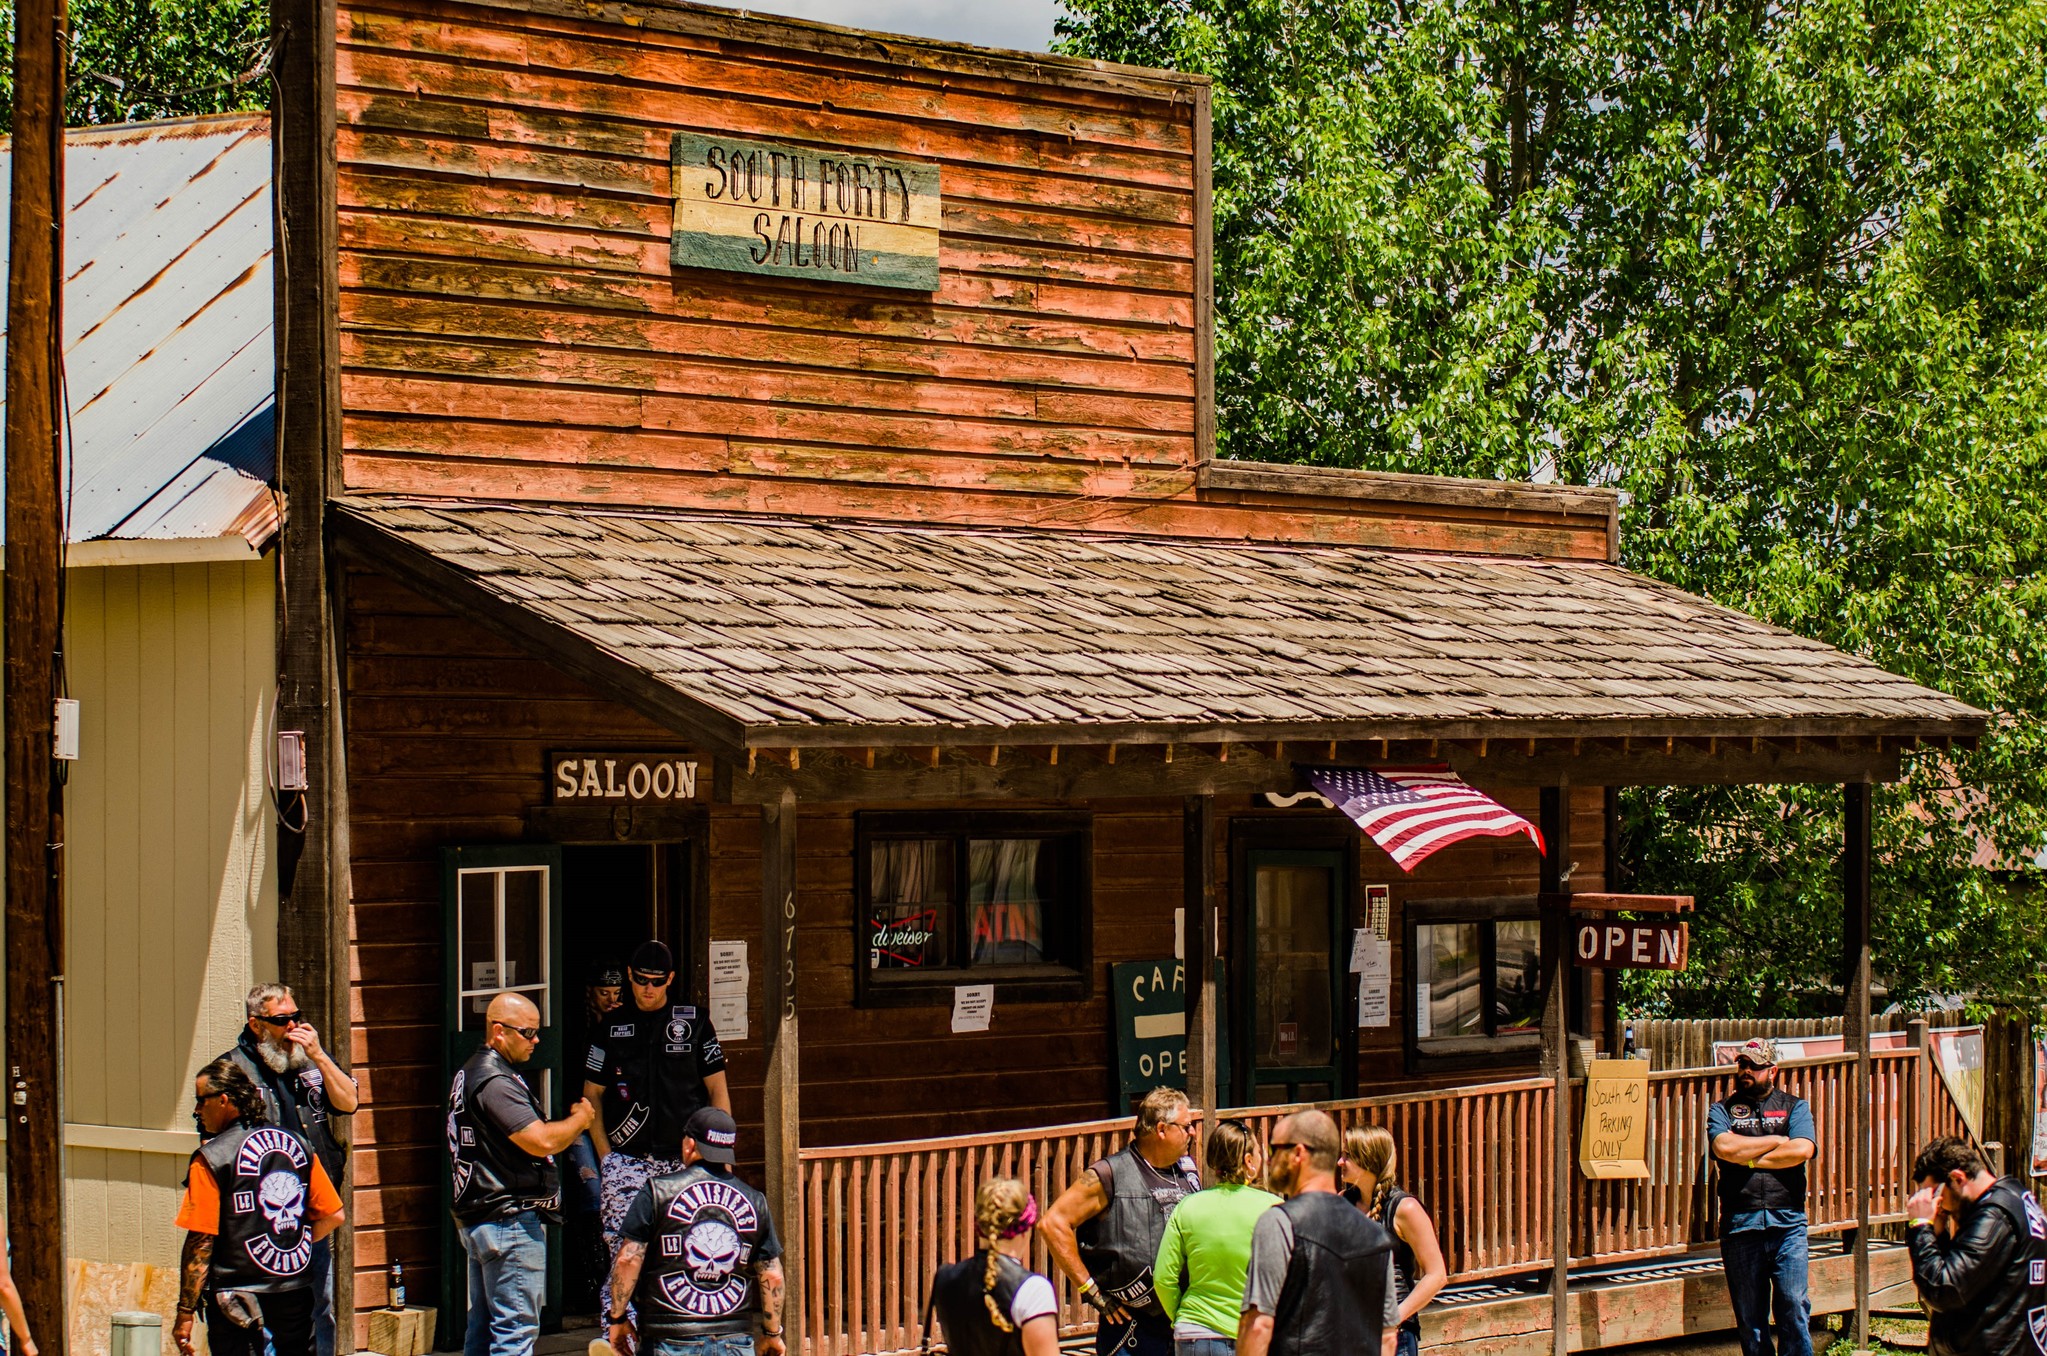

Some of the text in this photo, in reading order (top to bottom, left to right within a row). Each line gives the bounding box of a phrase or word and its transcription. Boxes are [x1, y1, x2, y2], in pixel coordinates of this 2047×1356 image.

[705, 146, 915, 222] SOUTH FORTY
[749, 212, 861, 273] SALOON
[556, 758, 698, 799] SALOON
[872, 923, 933, 947] dweiser
[973, 902, 1038, 944] ATM
[784, 890, 796, 1022] 6735
[1577, 925, 1680, 964] OPEN
[1132, 965, 1185, 1002] CAF
[1138, 1050, 1187, 1078] OPE
[1591, 1079, 1640, 1107] South 40
[1599, 1111, 1633, 1142] PARKING
[239, 1130, 305, 1172] PUNISHERS
[1592, 1139, 1622, 1161] ONLY
[673, 1183, 755, 1226] PUNISHERS
[667, 1276, 744, 1314] COLORADO
